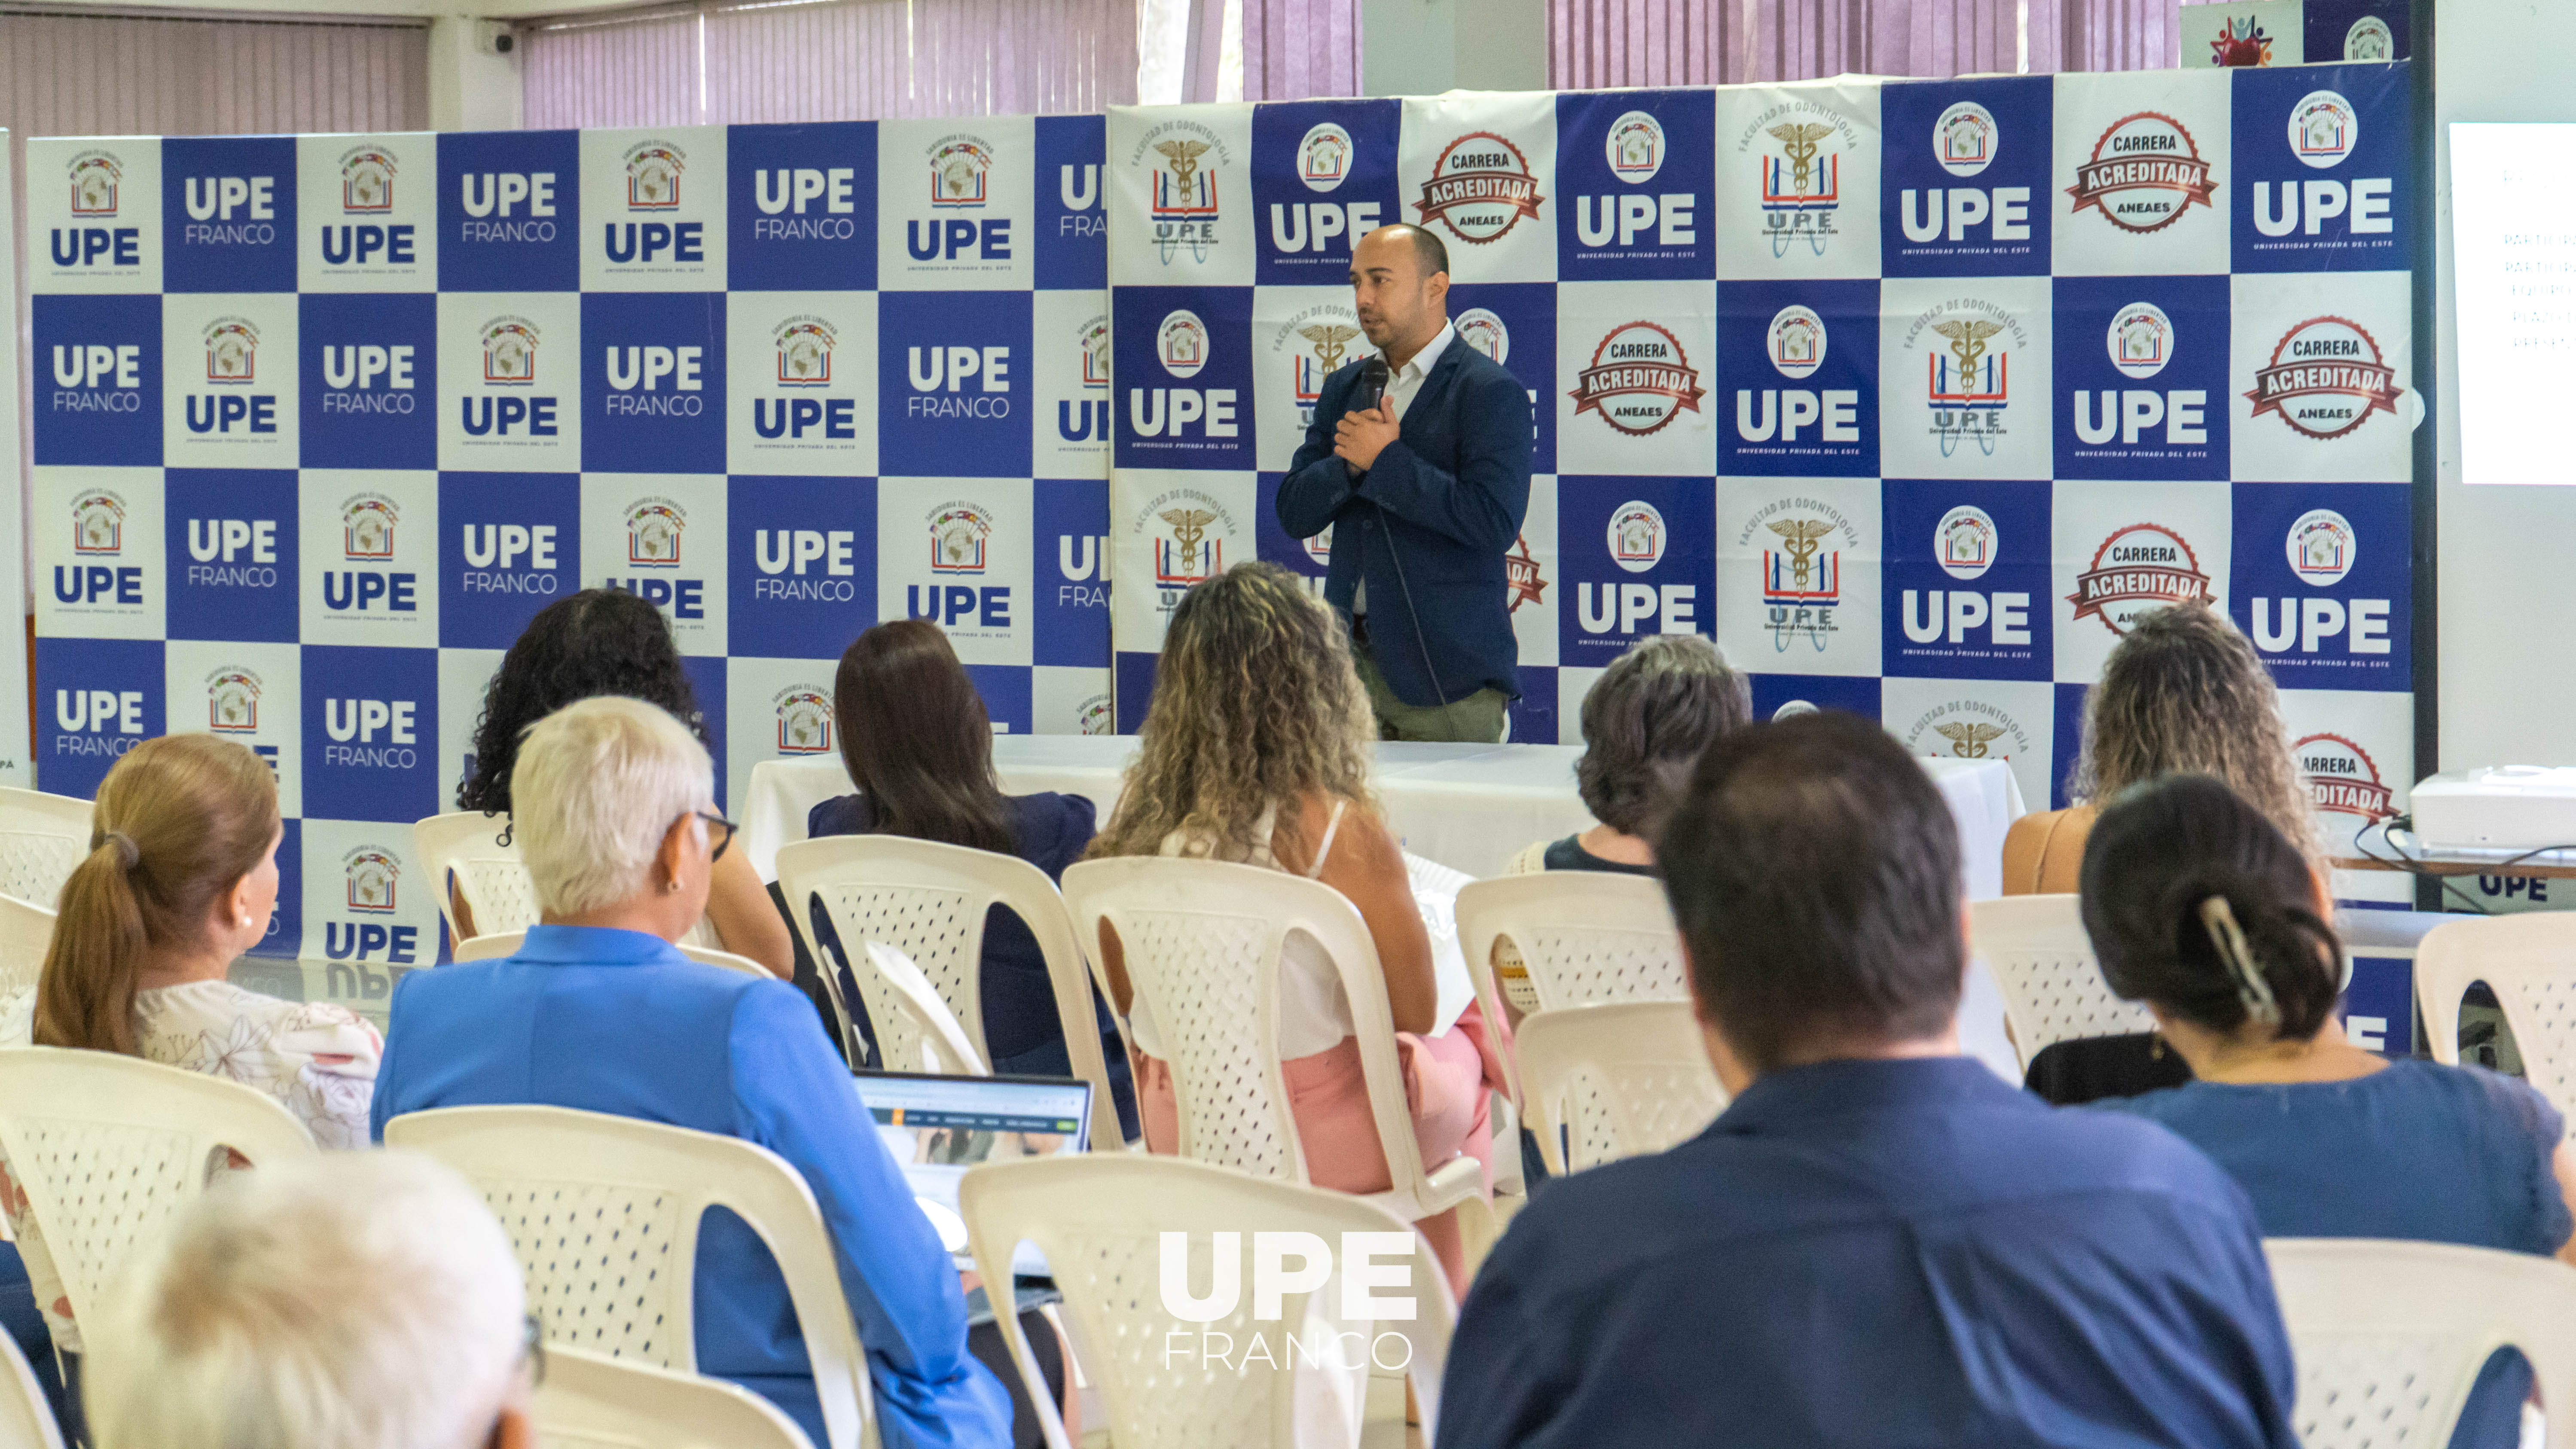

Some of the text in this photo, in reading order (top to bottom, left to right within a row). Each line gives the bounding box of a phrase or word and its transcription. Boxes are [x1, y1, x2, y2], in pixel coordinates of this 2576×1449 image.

[1779, 102, 1791, 113] DE
[2113, 135, 2176, 152] CARRERA
[1452, 153, 1510, 168] CARRERA
[2087, 162, 2201, 190] ACREDITADA
[186, 177, 274, 220] UPE
[463, 173, 555, 217] UPE
[756, 168, 854, 214] UPE
[1431, 179, 1530, 203] ACREDITADA
[1901, 187, 2030, 242] UPE
[2117, 203, 2170, 213] ANEAES
[2254, 178, 2393, 236] UPE
[463, 221, 556, 242] FRANCO
[755, 218, 854, 239] FRANCO
[1061, 215, 1107, 237] FRA
[1156, 224, 1212, 238] UPE
[1270, 202, 1381, 253] UPE
[1459, 216, 1503, 226] ANEAES
[1577, 194, 1695, 247] UPE
[1768, 213, 1831, 228] UPE
[52, 228, 139, 266] UPE
[186, 224, 275, 244] FRANCO
[322, 225, 415, 264] UPE
[606, 223, 703, 262] UPE
[908, 219, 1011, 261] UPE
[2504, 234, 2576, 245] PARTICIPA
[2505, 262, 2576, 272] PARTICIPA
[1325, 305, 1361, 323] ODONT
[1611, 344, 1667, 358] CARRERA
[2293, 340, 2359, 356] CARRERA
[54, 346, 139, 387] UPE
[324, 346, 414, 388] UPE
[607, 347, 702, 390] UPE
[909, 347, 1009, 392] UPE
[1587, 369, 1690, 393] ACREDITADA
[2267, 369, 2386, 394] ACREDITADA
[54, 391, 140, 412] FRANCO
[187, 395, 276, 433] UPE
[324, 393, 415, 414] FRANCO
[607, 395, 702, 416] FRANCO
[909, 397, 1009, 418] FRANCO
[1131, 388, 1238, 436] UPE
[1615, 407, 1662, 417] ANEAES
[2298, 409, 2352, 418] ANEAES
[463, 397, 557, 436] UPE
[755, 399, 855, 439] UPE
[1737, 390, 1859, 442] UPE
[1935, 412, 1999, 427] UPE
[2075, 390, 2207, 444] UPE
[1779, 499, 1792, 509] DE
[189, 519, 276, 563] UPE
[464, 525, 556, 569] UPE
[756, 530, 854, 575] UPE
[2113, 547, 2176, 561] CARRERA
[55, 566, 142, 604] UPE
[189, 566, 277, 587] FRANCO
[464, 572, 557, 594] FRANCO
[2087, 573, 2201, 599] ACREDITADA
[324, 572, 416, 611] UPE
[756, 579, 854, 601] FRANCO
[1059, 586, 1108, 607] FRA
[907, 584, 1011, 627] UPE
[1578, 583, 1697, 635] UPE
[1770, 608, 1831, 624] UPE
[1903, 590, 2031, 644] UPE
[2252, 597, 2391, 654] UPE
[57, 690, 143, 733] UPE
[326, 699, 415, 744] UPE
[326, 743, 416, 769] FRANCO
[2304, 757, 2356, 773] ARRERA
[2478, 872, 2549, 901] UPE
[326, 922, 417, 963] UPE
